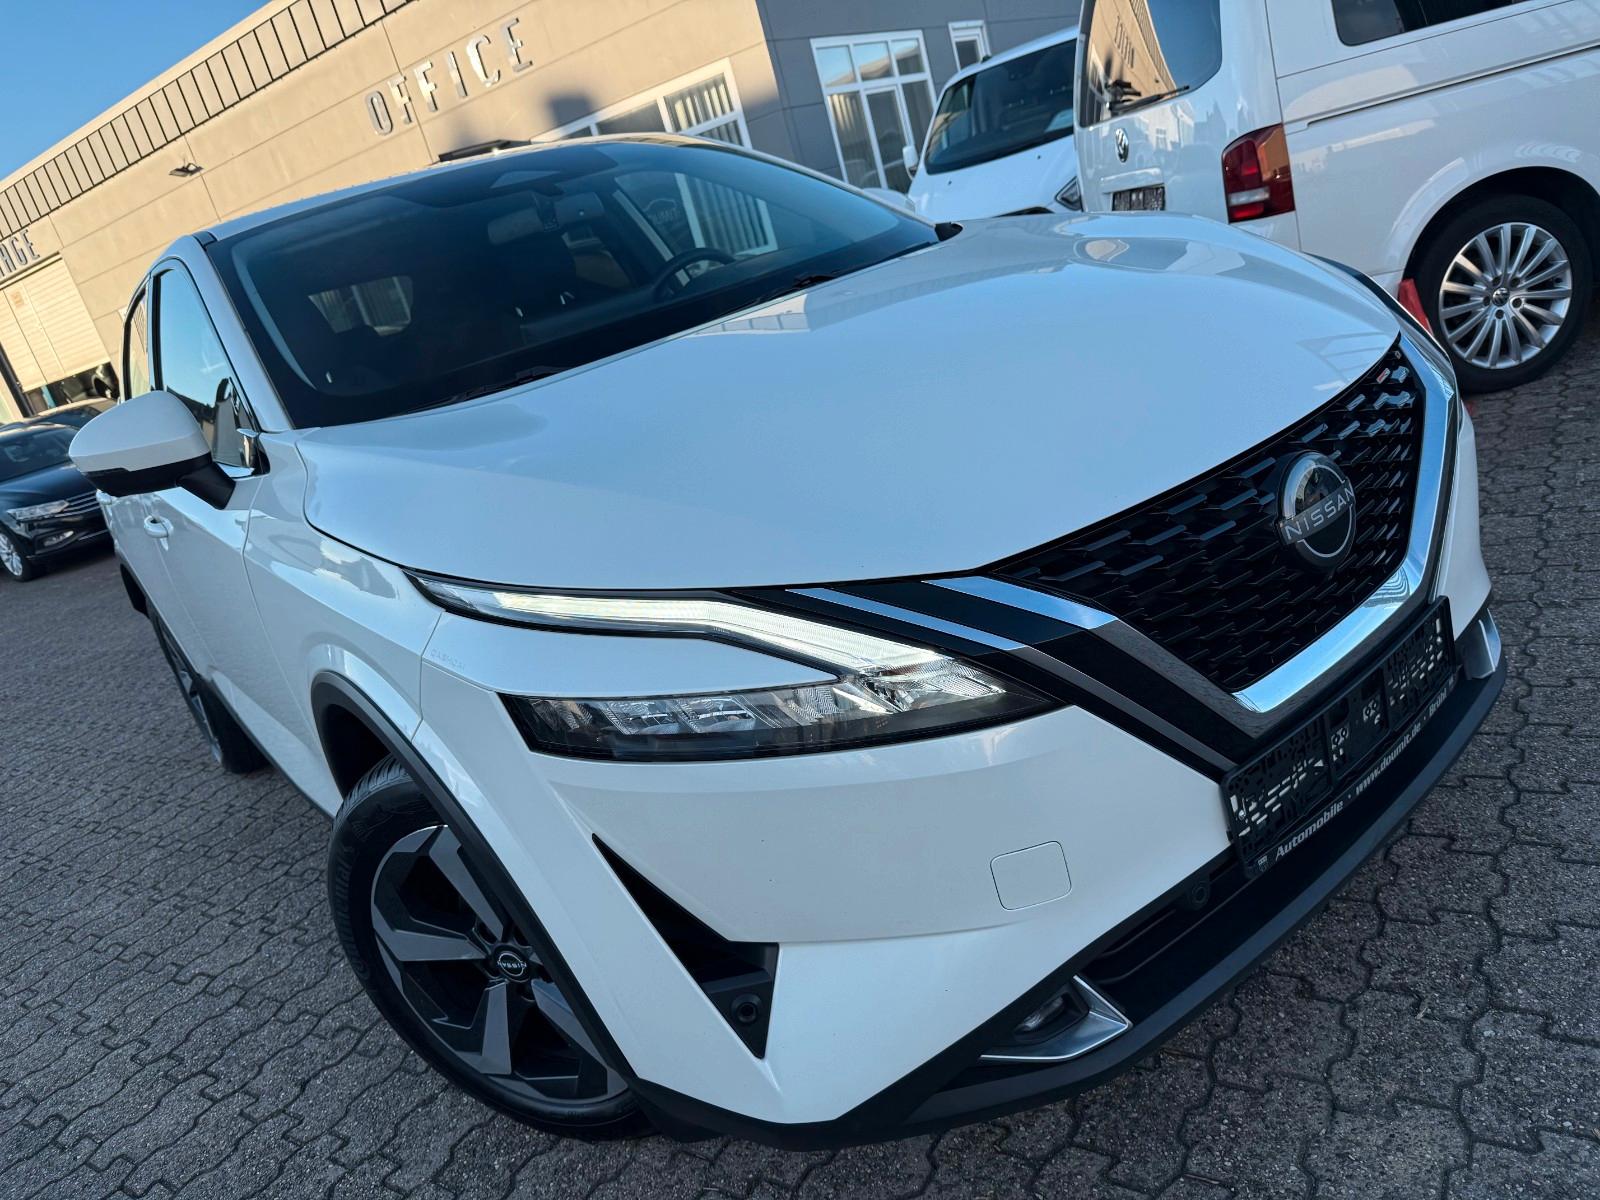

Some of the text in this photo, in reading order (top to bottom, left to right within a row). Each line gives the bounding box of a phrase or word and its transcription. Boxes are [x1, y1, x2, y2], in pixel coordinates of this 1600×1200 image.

[364, 17, 534, 136] OFFICE
[1284, 487, 1354, 540] NISSAN
[1275, 800, 1343, 861] Automobile
